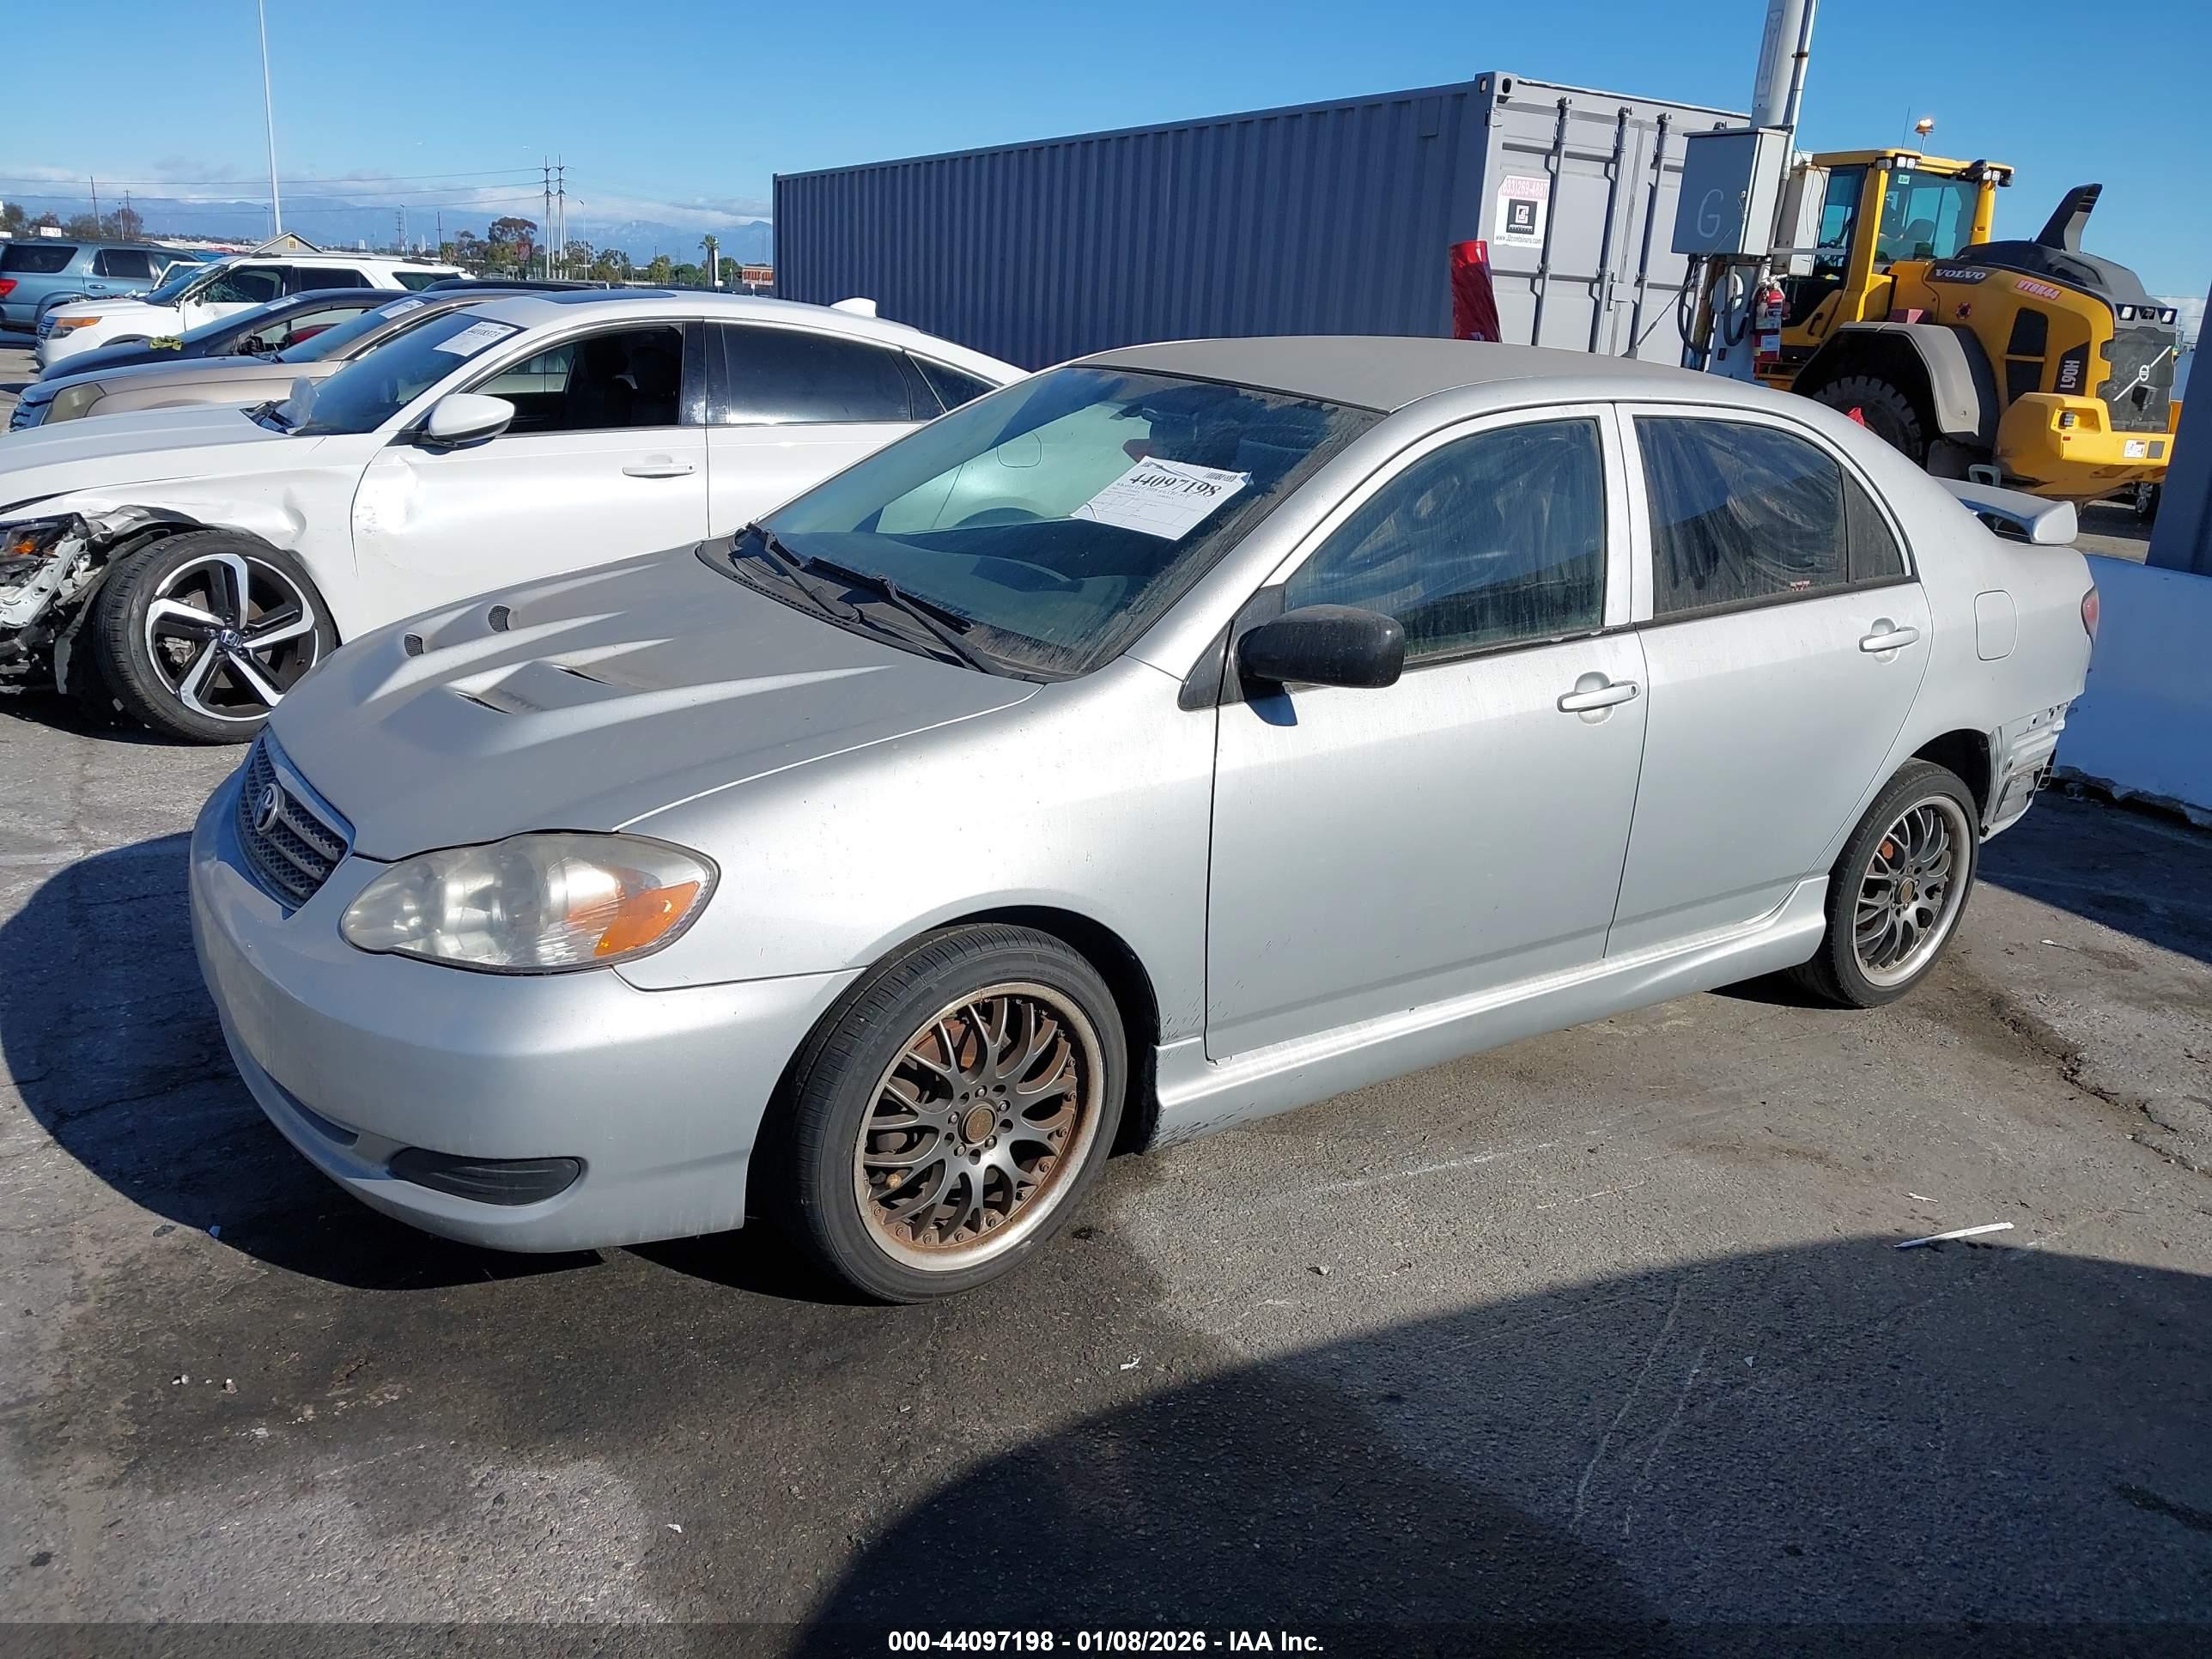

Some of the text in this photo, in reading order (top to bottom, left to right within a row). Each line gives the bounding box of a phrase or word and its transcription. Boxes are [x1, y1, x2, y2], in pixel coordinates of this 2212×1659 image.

[1697, 188, 1723, 238] G
[1936, 269, 1986, 280] VOLVO
[2059, 360, 2081, 389] L90H
[1129, 473, 1222, 497] 44097198
